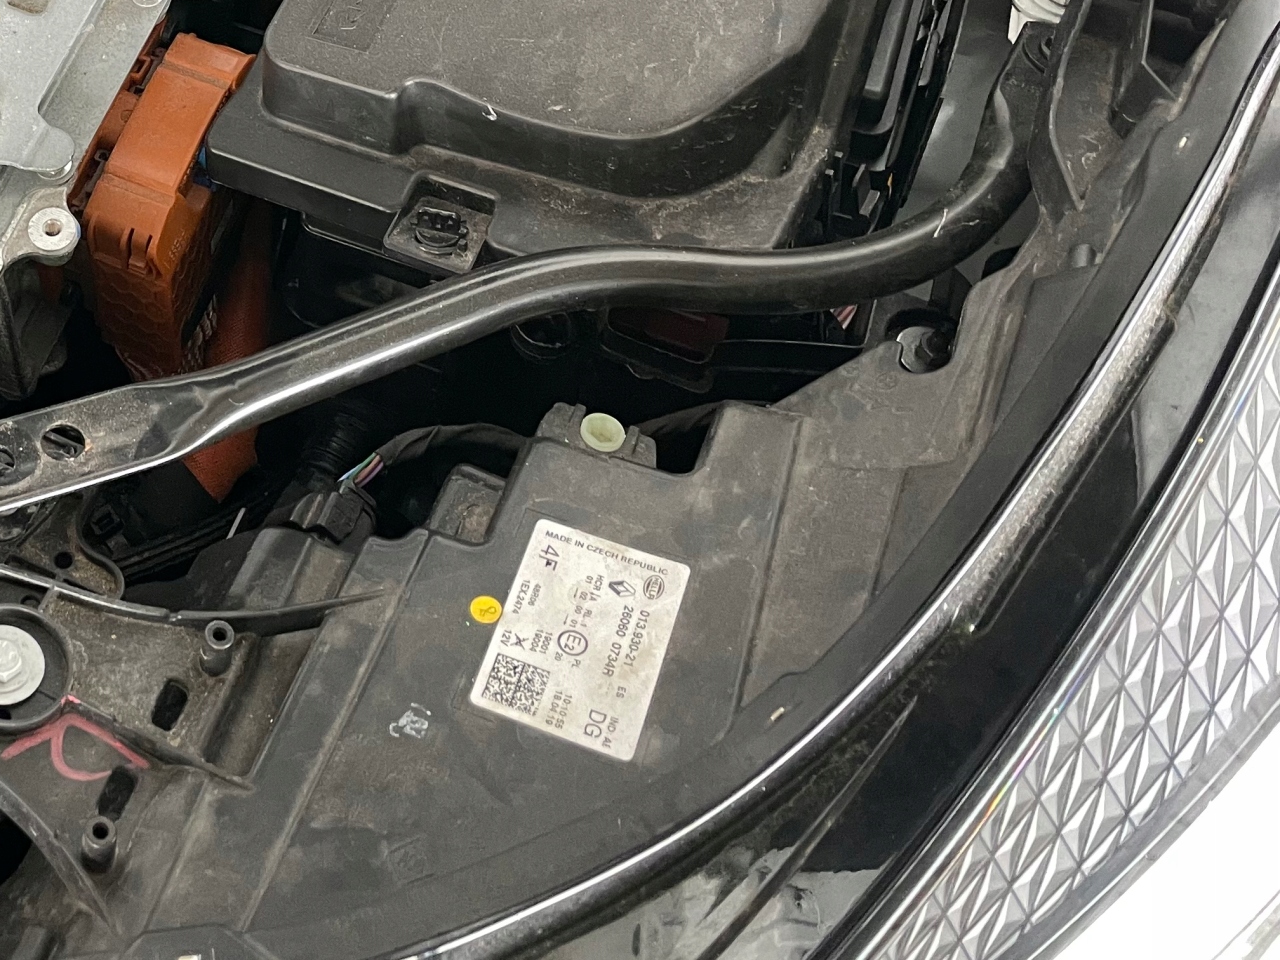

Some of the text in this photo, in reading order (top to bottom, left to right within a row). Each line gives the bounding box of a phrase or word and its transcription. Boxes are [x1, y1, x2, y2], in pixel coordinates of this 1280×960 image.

[546, 530, 667, 575] MADE IN CZECH REPUBLIC
[593, 575, 604, 591] HCR
[647, 577, 660, 600] HELLA
[501, 630, 512, 646] 12V
[624, 610, 650, 667] 013.930-21
[583, 605, 634, 738] 26060 0734R DG
[616, 686, 626, 698] ES
[545, 691, 562, 725] 18.04.19
